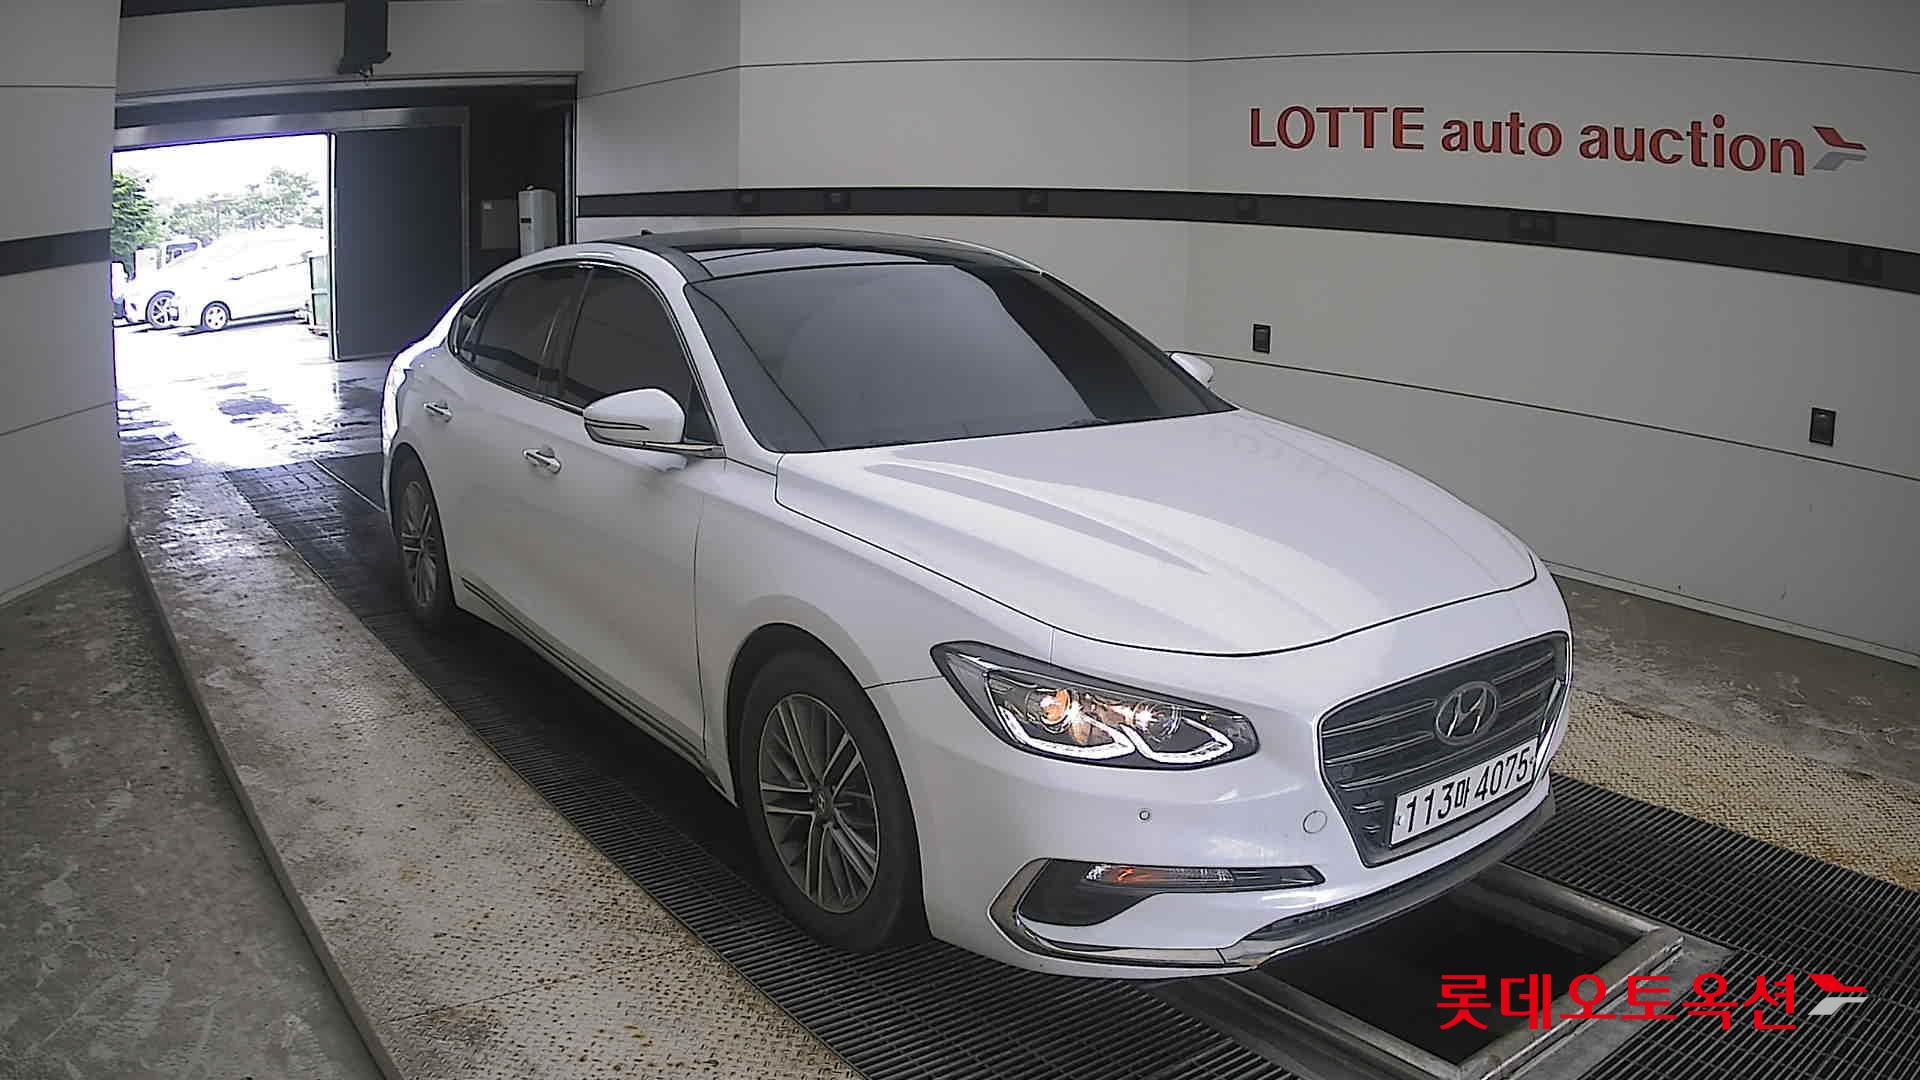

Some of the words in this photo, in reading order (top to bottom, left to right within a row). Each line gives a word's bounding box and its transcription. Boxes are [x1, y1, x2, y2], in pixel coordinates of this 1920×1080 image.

[1250, 106, 1425, 150] LOTTE
[1441, 112, 1563, 157] auto
[1579, 114, 1806, 176] auction
[1406, 777, 1470, 833] 113마
[1474, 746, 1531, 800] 4075
